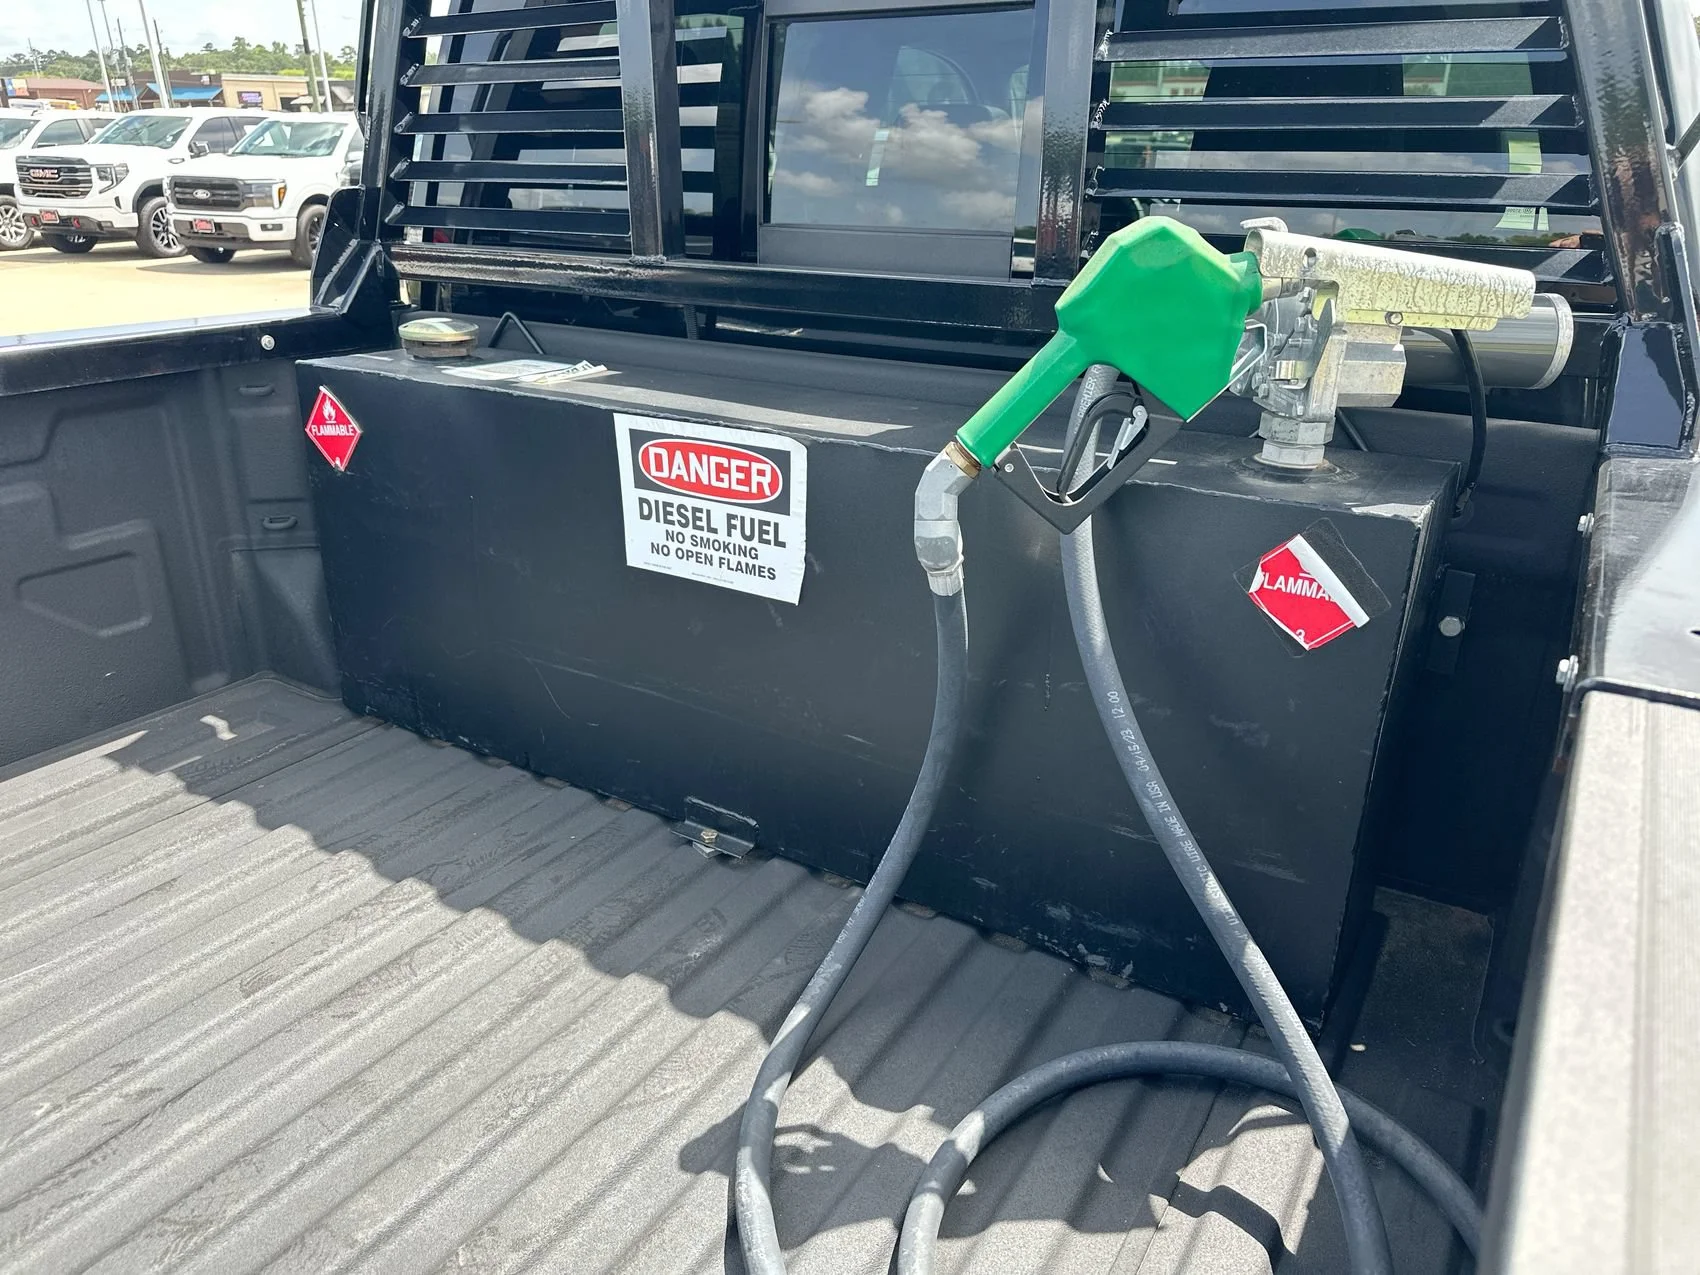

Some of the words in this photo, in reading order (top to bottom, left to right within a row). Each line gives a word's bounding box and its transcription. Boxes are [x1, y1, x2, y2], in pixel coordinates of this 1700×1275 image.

[29, 168, 58, 179] GMC
[311, 424, 355, 437] FLAMMABLE
[648, 446, 772, 497] DANGER
[638, 496, 718, 535] DIESEL
[726, 512, 787, 549] FUEL
[665, 528, 686, 545] NO
[690, 534, 759, 561] SMOKING
[650, 541, 671, 557] NO
[675, 547, 714, 567] OPEN
[718, 556, 777, 581] FLAMES
[1146, 781, 1163, 799] USA
[1155, 801, 1171, 813] IN
[1164, 816, 1186, 838] MADE
